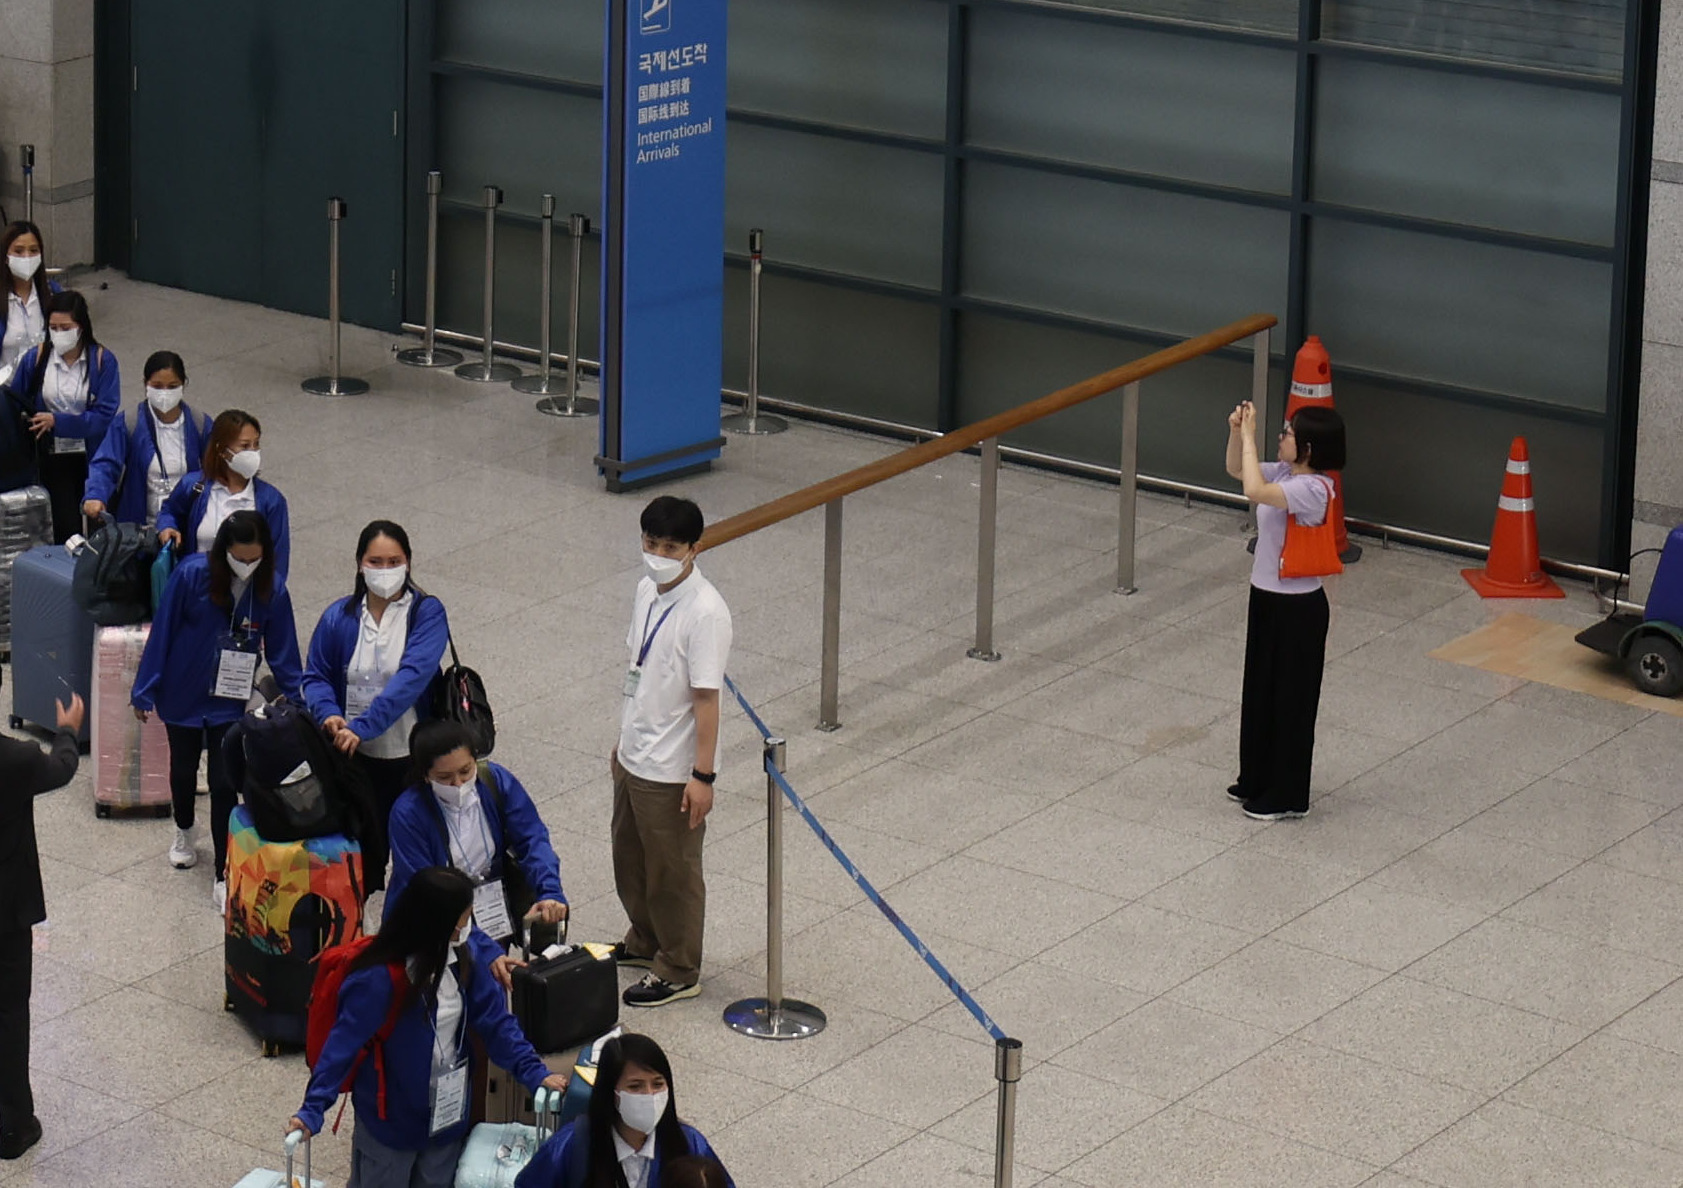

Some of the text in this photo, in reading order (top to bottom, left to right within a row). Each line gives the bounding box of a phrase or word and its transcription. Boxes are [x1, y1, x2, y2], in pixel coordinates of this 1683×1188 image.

[638, 43, 708, 74] 국제선도착
[637, 116, 712, 146] International
[636, 142, 680, 164] Arrivals
